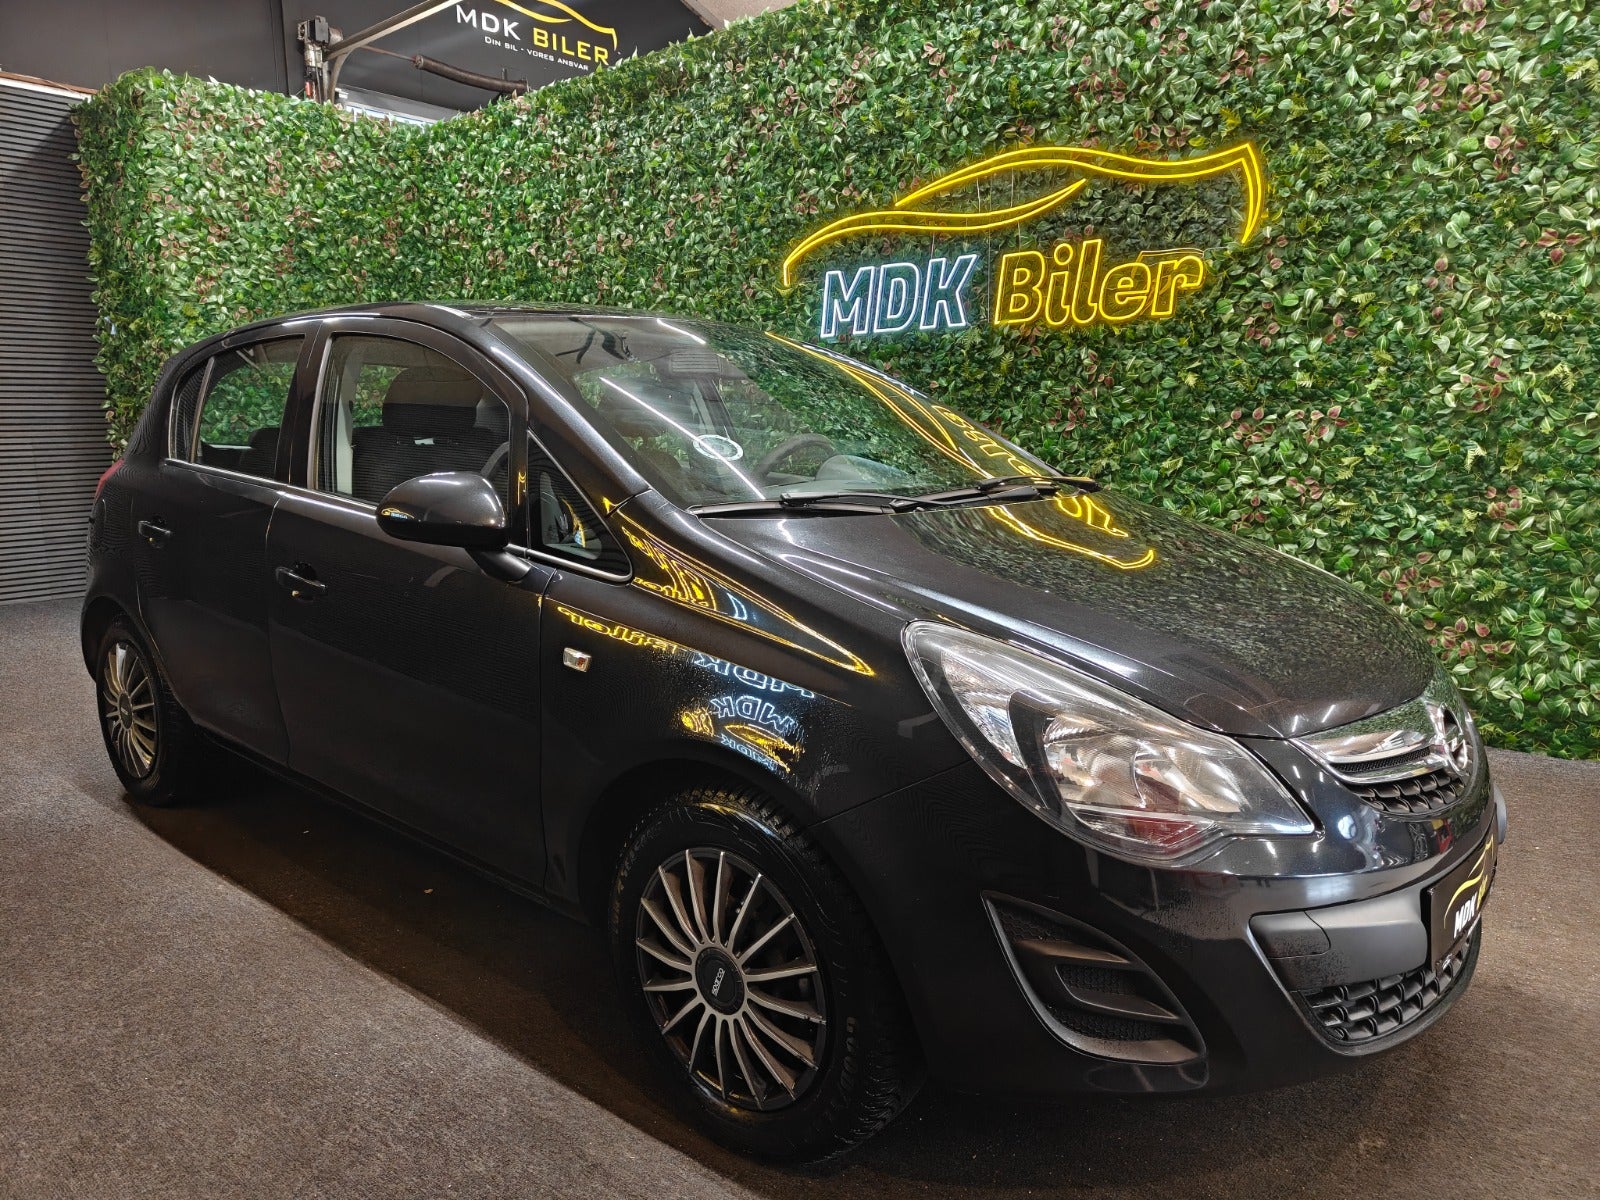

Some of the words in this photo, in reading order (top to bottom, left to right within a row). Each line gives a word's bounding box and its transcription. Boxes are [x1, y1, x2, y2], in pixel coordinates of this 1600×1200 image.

[456, 4, 521, 41] MDK
[533, 27, 609, 66] BILER
[484, 36, 502, 47] DIN
[504, 42, 519, 52] BIL
[527, 48, 554, 62] VORES
[557, 58, 589, 71] ANSVAR
[820, 253, 979, 339] MDK
[994, 238, 1205, 326] Biler
[1454, 891, 1478, 939] MDK
